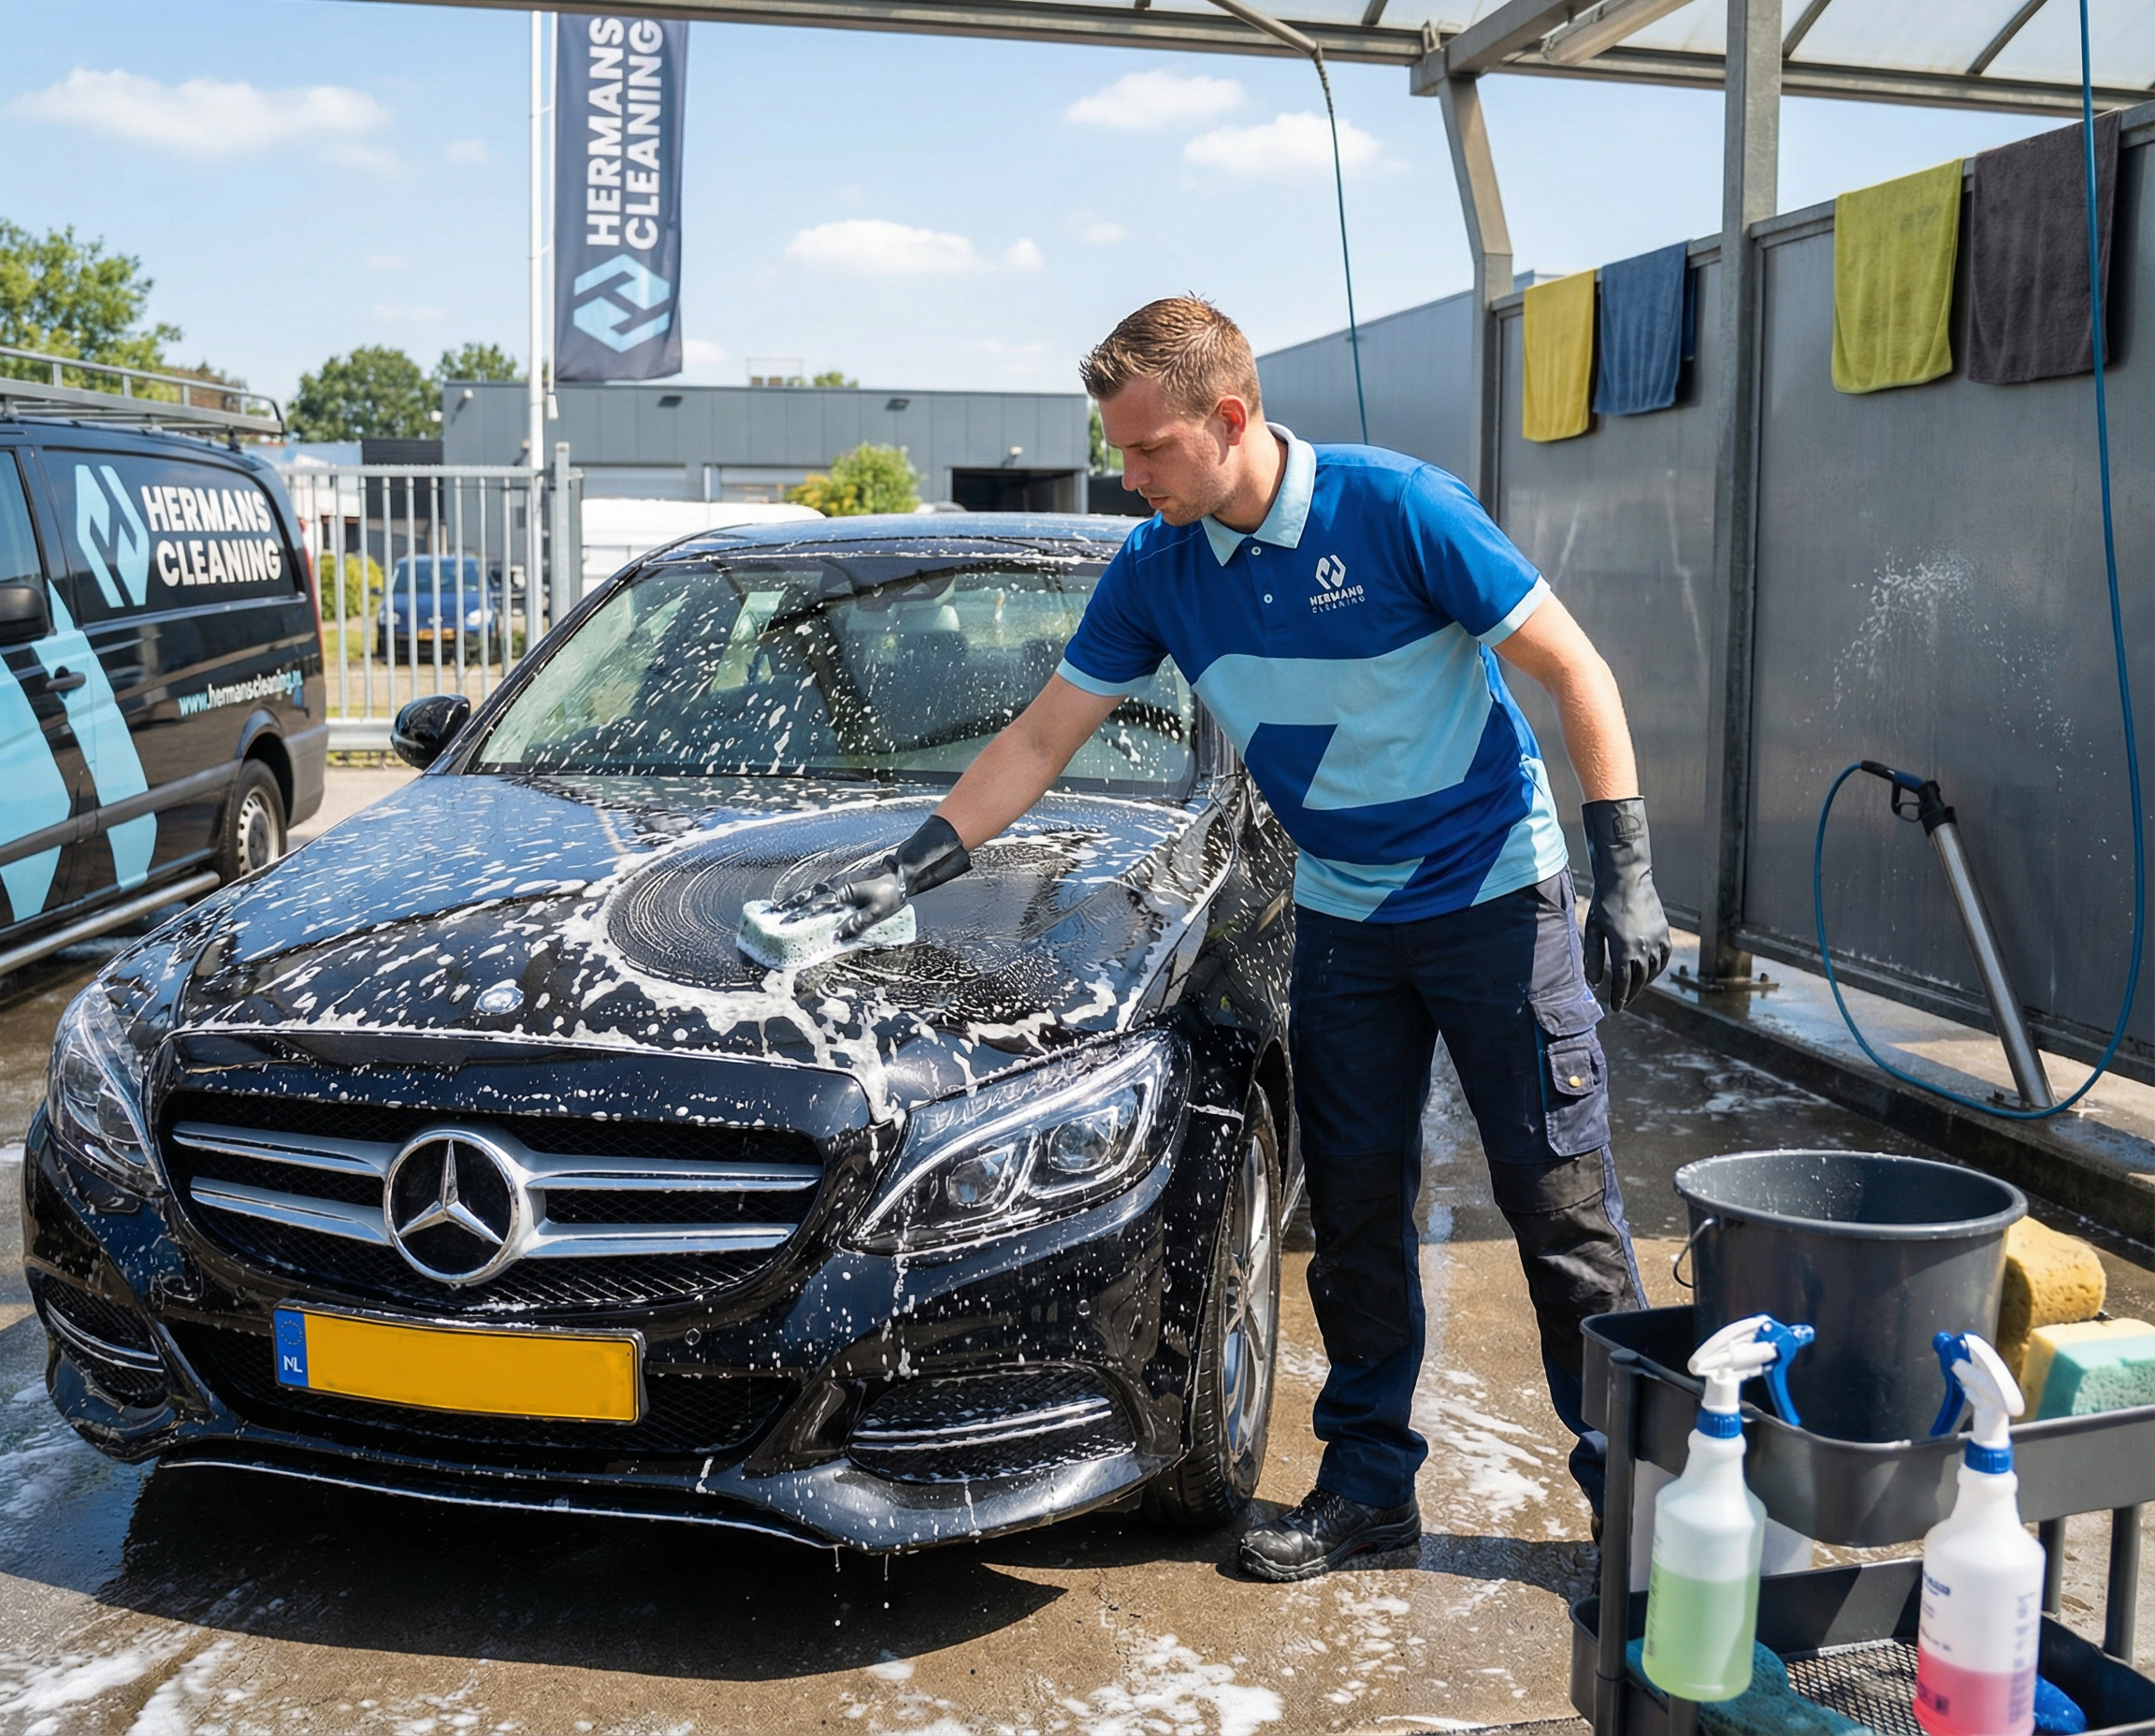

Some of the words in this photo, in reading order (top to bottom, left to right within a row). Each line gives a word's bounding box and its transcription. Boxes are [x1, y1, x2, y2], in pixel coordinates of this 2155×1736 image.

[586, 17, 625, 247] HERMANS
[625, 19, 664, 251] CLEANING
[140, 485, 272, 533] HERMANS
[156, 538, 282, 587] CLEANING
[282, 1354, 304, 1374] NL
